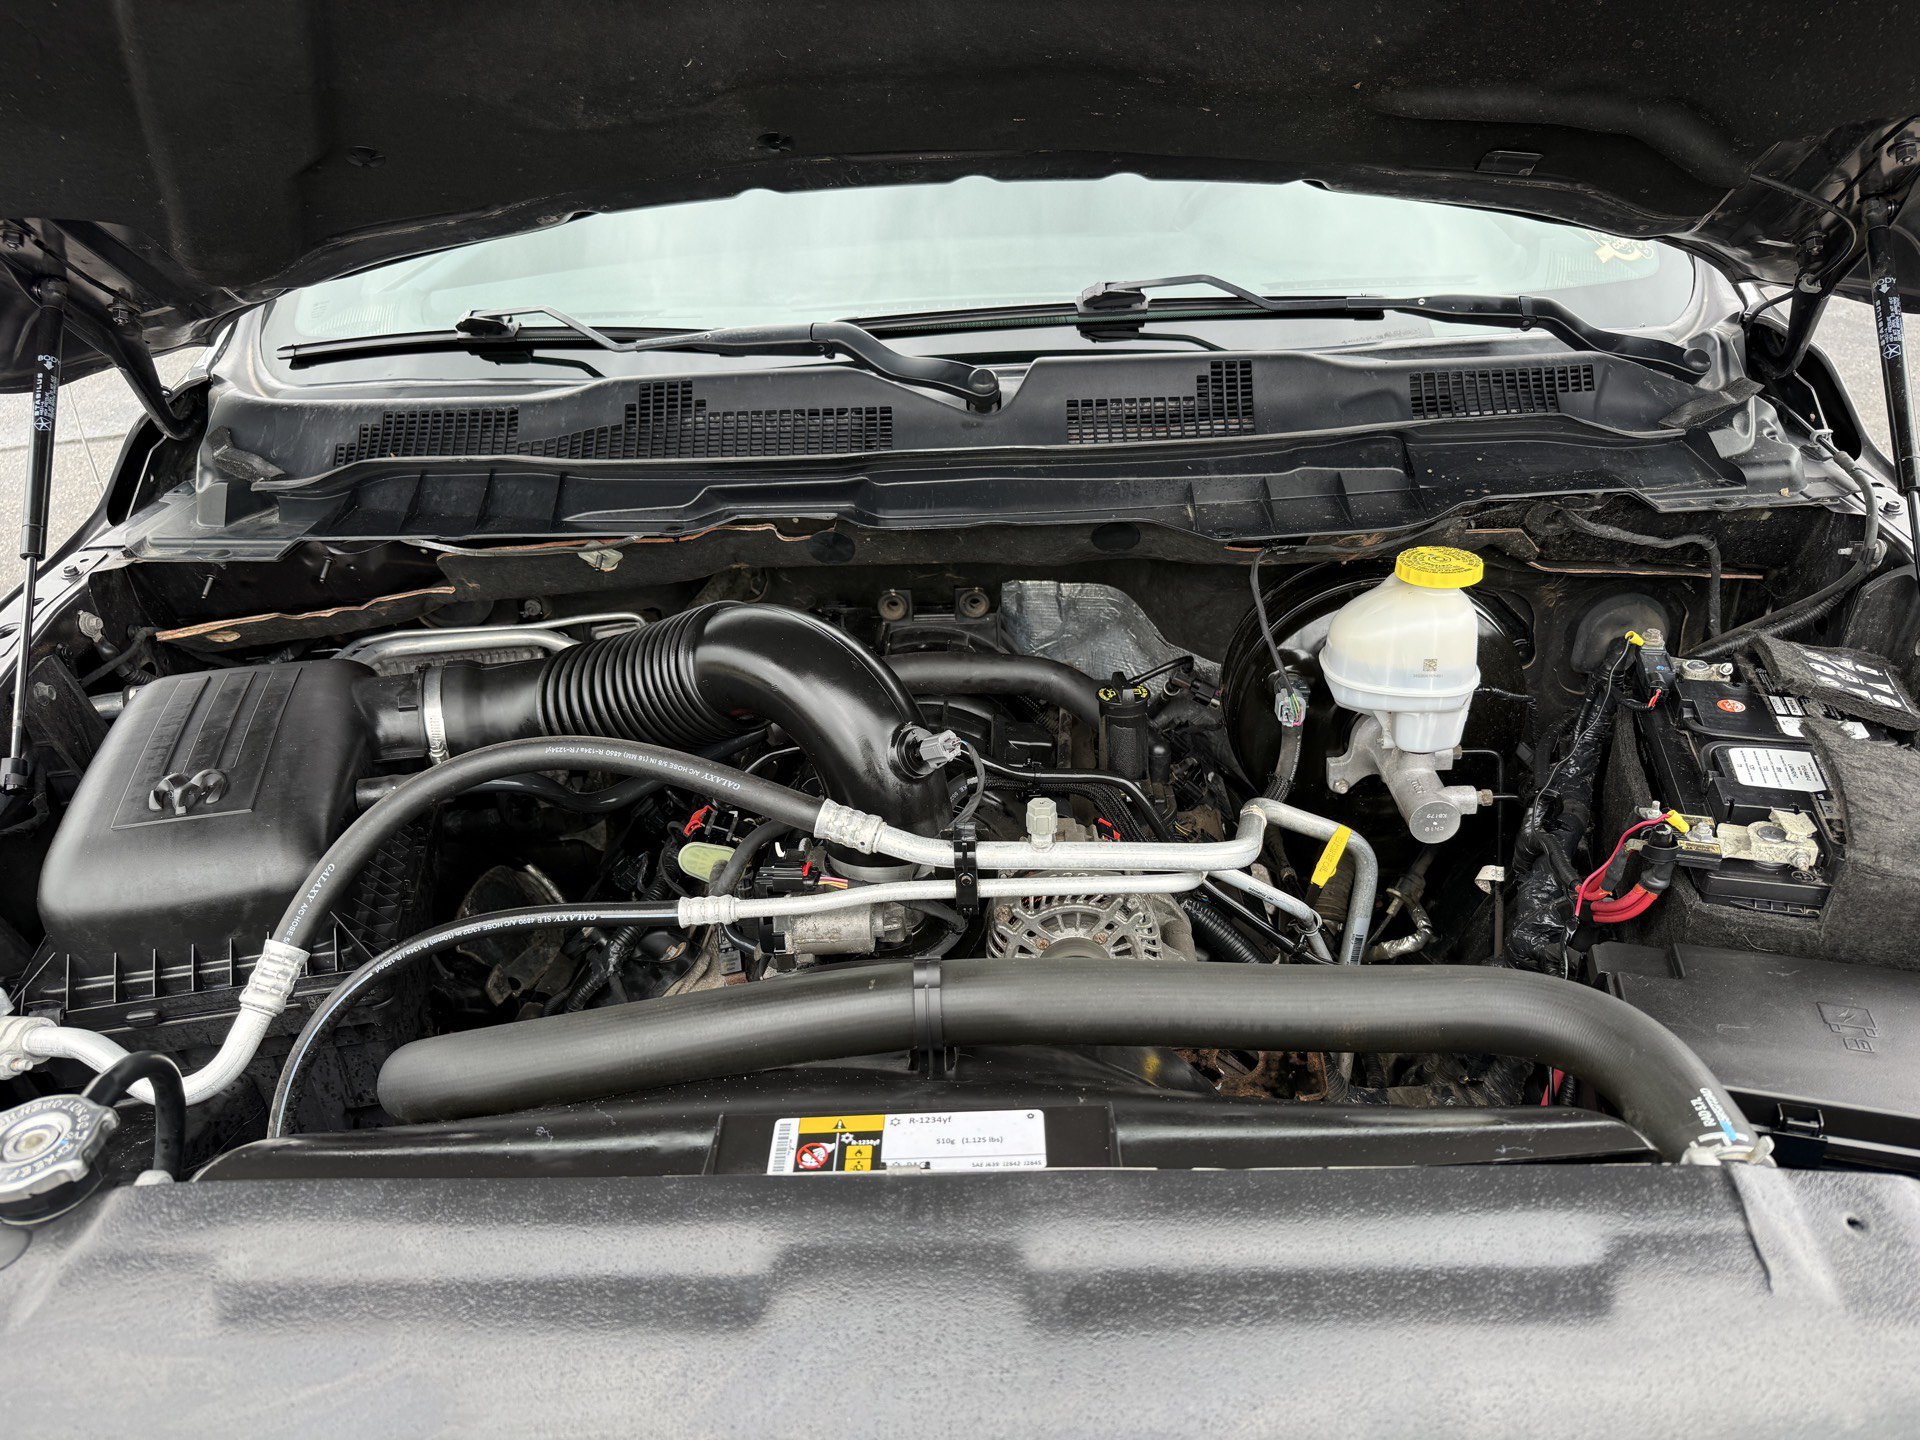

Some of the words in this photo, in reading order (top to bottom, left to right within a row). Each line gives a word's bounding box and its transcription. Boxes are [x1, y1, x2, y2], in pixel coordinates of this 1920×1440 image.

[1875, 300, 1885, 346] STABILUS
[34, 373, 43, 416] STABILUS
[669, 762, 688, 774] HOSE
[688, 767, 701, 777] A/C
[701, 772, 741, 791] GALAXY
[307, 863, 335, 903] GALAXY
[537, 914, 552, 923] SLE
[554, 913, 596, 922] GALAXY
[286, 915, 302, 937] HOSE
[483, 921, 502, 931] HOSE
[909, 1116, 952, 1125] R-1234yf
[936, 1137, 956, 1146] 510g
[961, 1137, 987, 1145] (1.125
[988, 1136, 1004, 1144] lbs)
